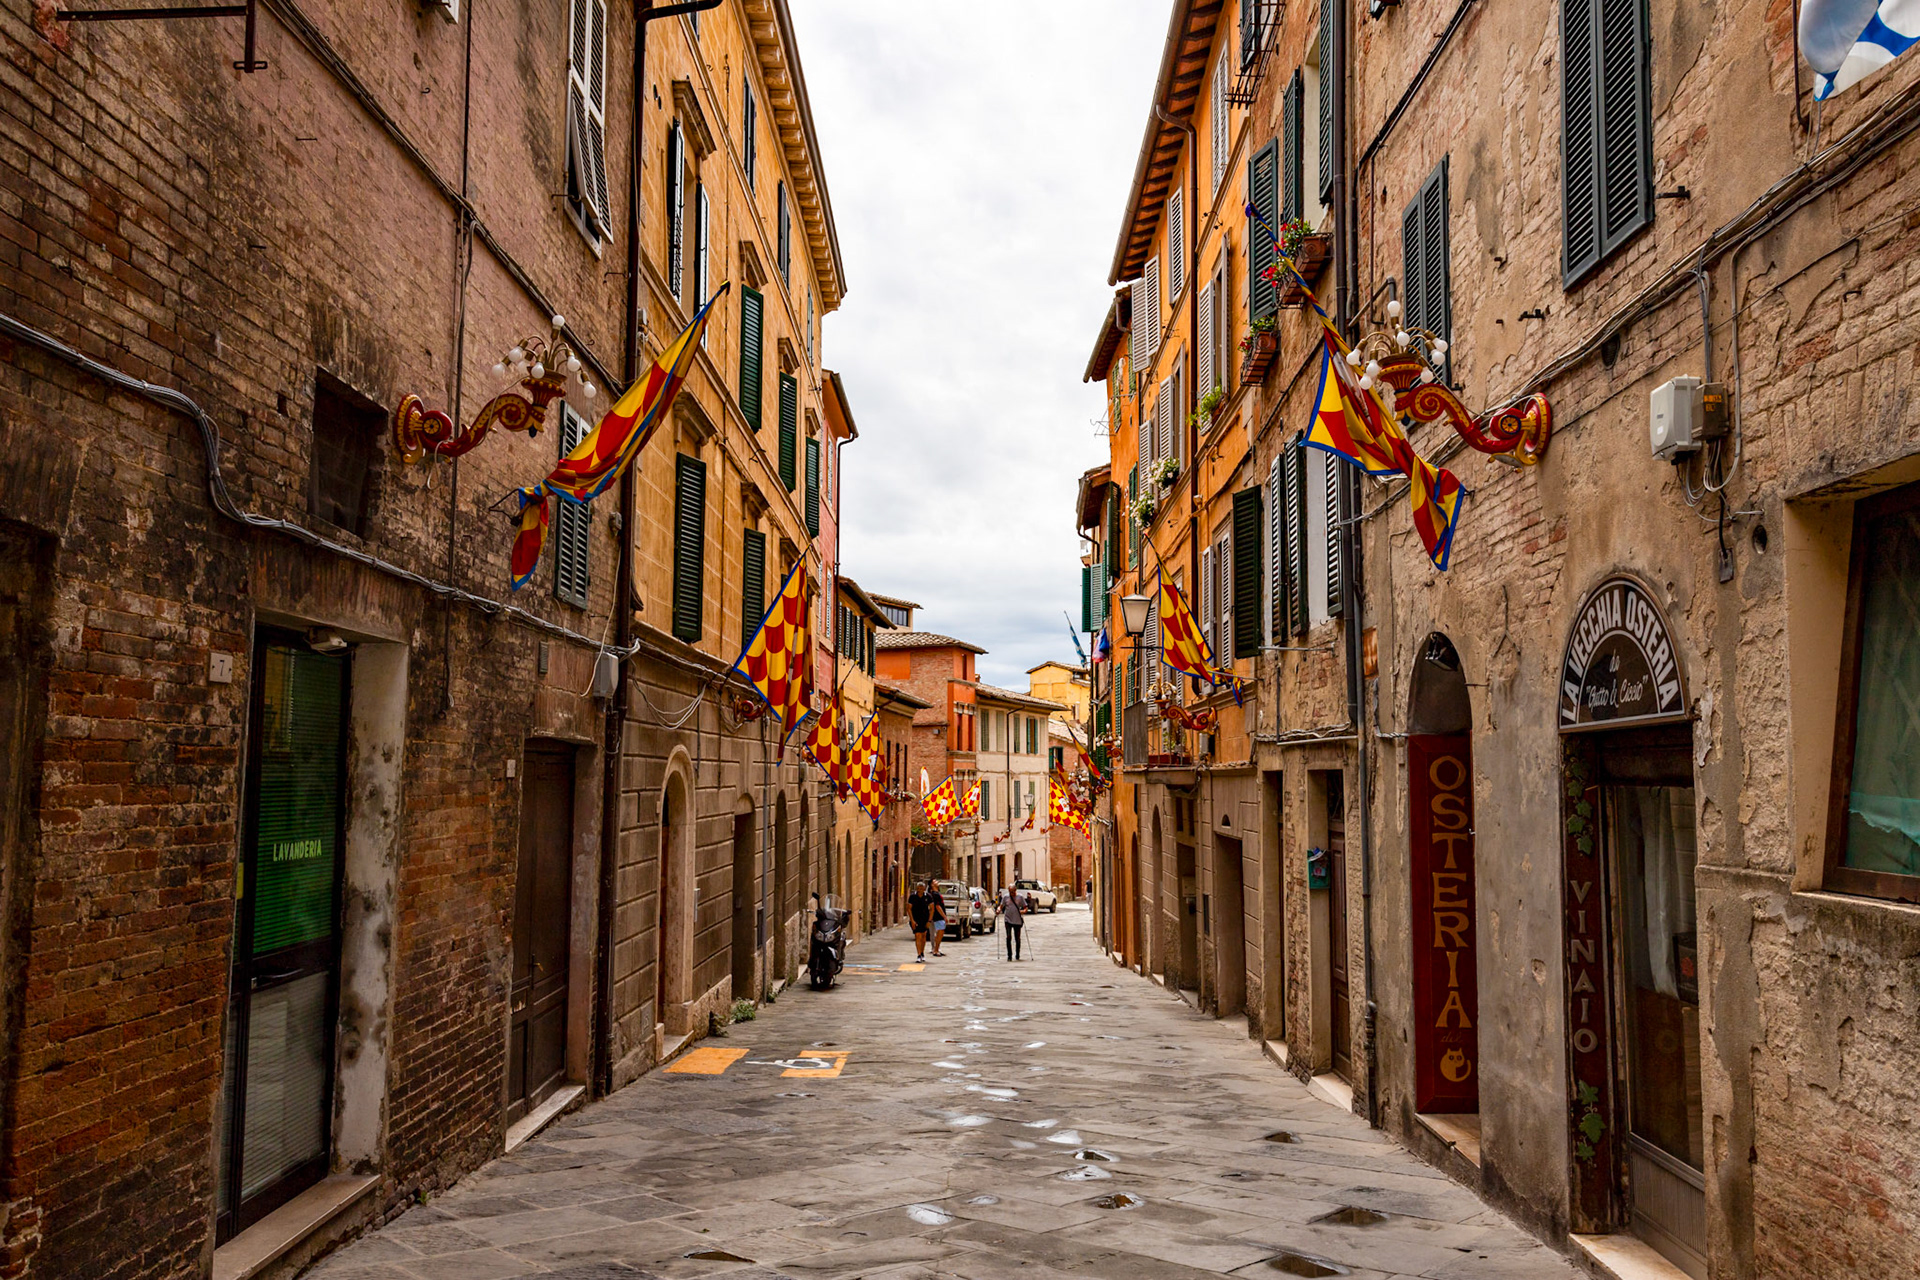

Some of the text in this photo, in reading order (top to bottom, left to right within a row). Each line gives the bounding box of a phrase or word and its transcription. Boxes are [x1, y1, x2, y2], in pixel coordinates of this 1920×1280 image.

[219, 659, 225, 677] 7
[1562, 589, 1679, 722] LA VECCHIA OSTERIA
[273, 839, 322, 861] LAVANDERIA
[1429, 755, 1472, 1029] OSTERIA
[1569, 880, 1599, 1053] VINAIO
